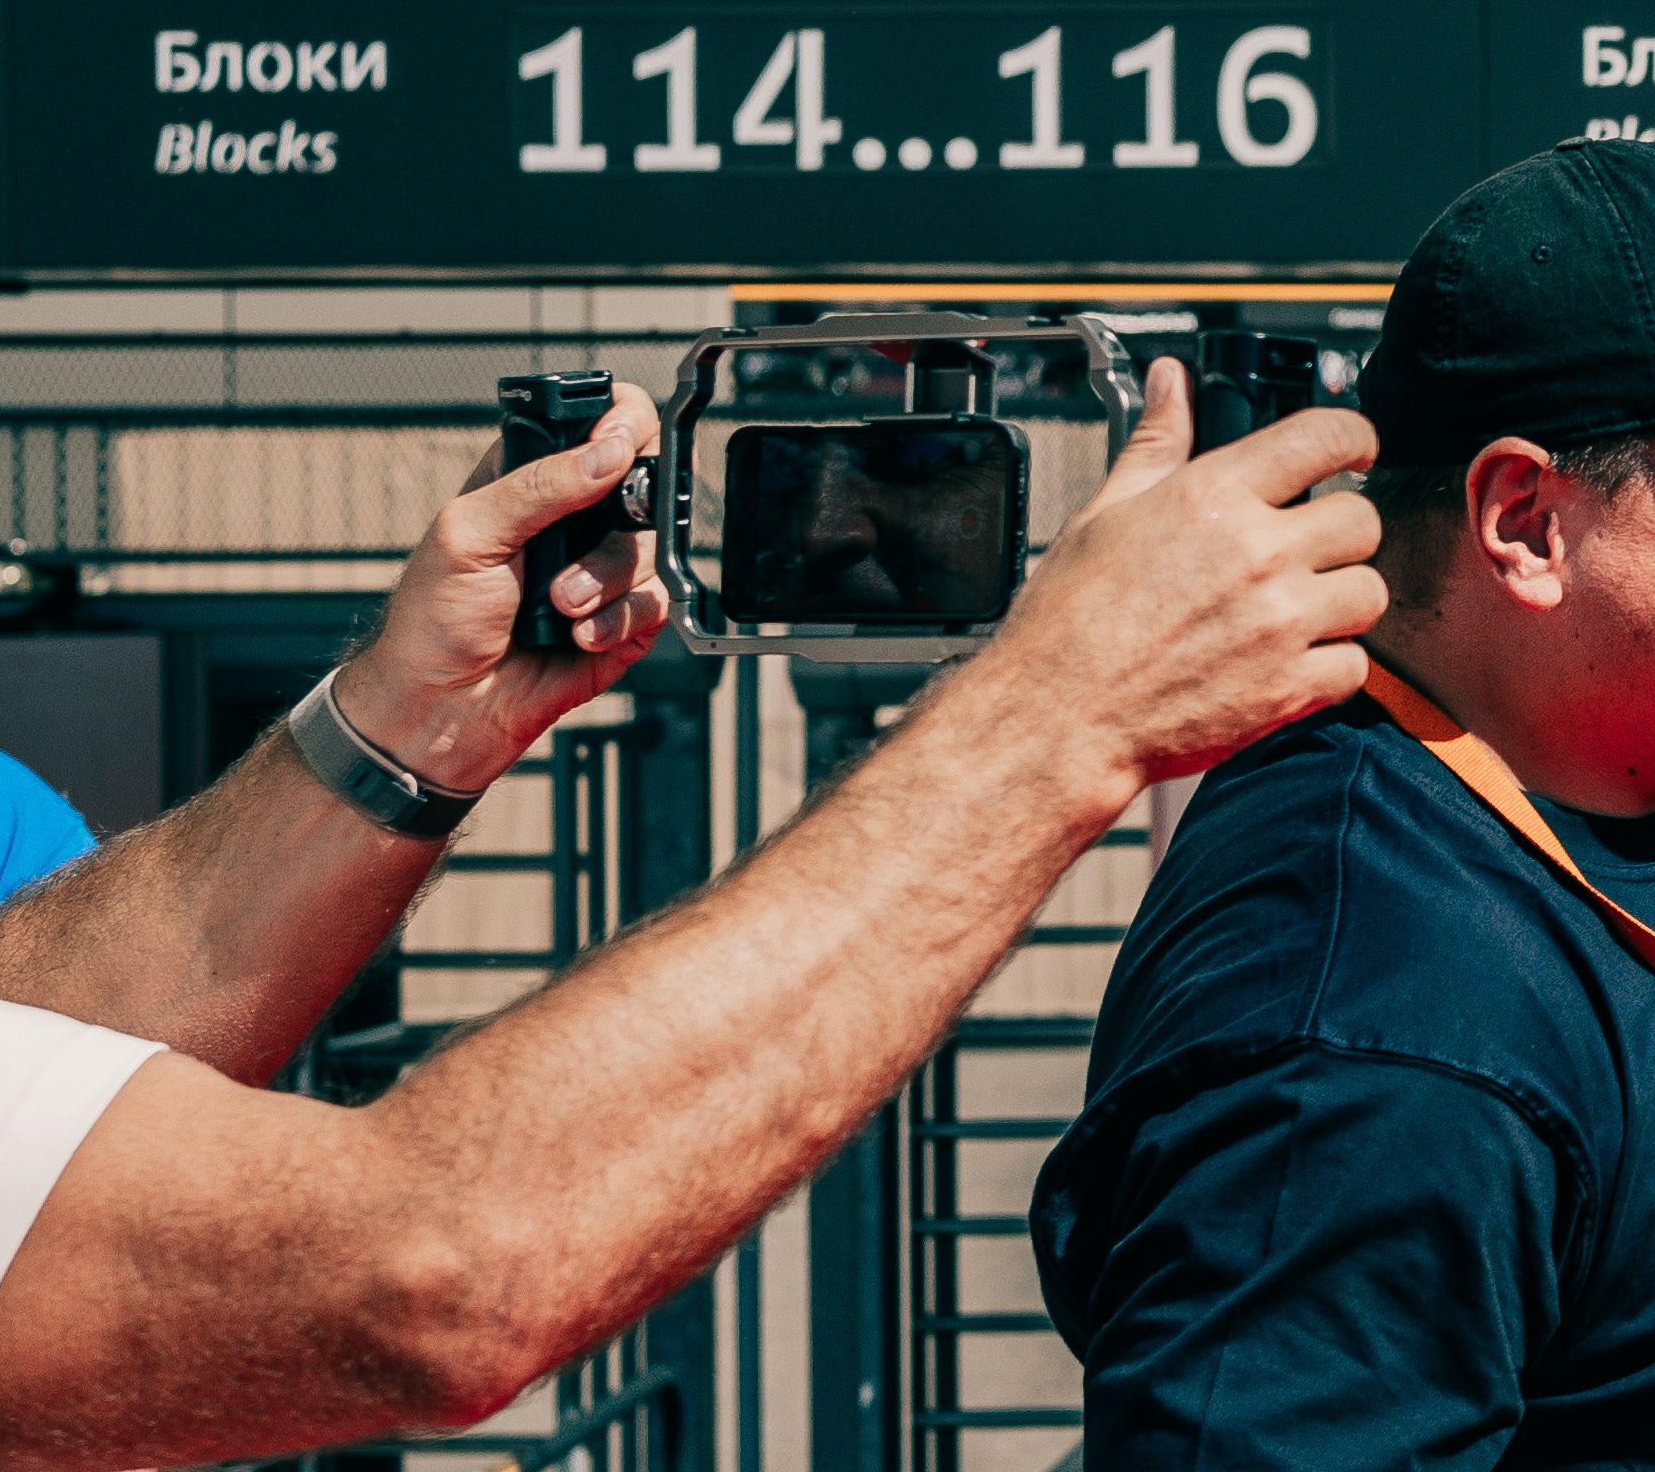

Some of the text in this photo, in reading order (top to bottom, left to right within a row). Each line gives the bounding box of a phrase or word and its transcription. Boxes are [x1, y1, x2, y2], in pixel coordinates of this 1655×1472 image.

[154, 29, 388, 93] Блоки
[518, 24, 1320, 172] 114...116
[154, 119, 339, 175] Blocks
